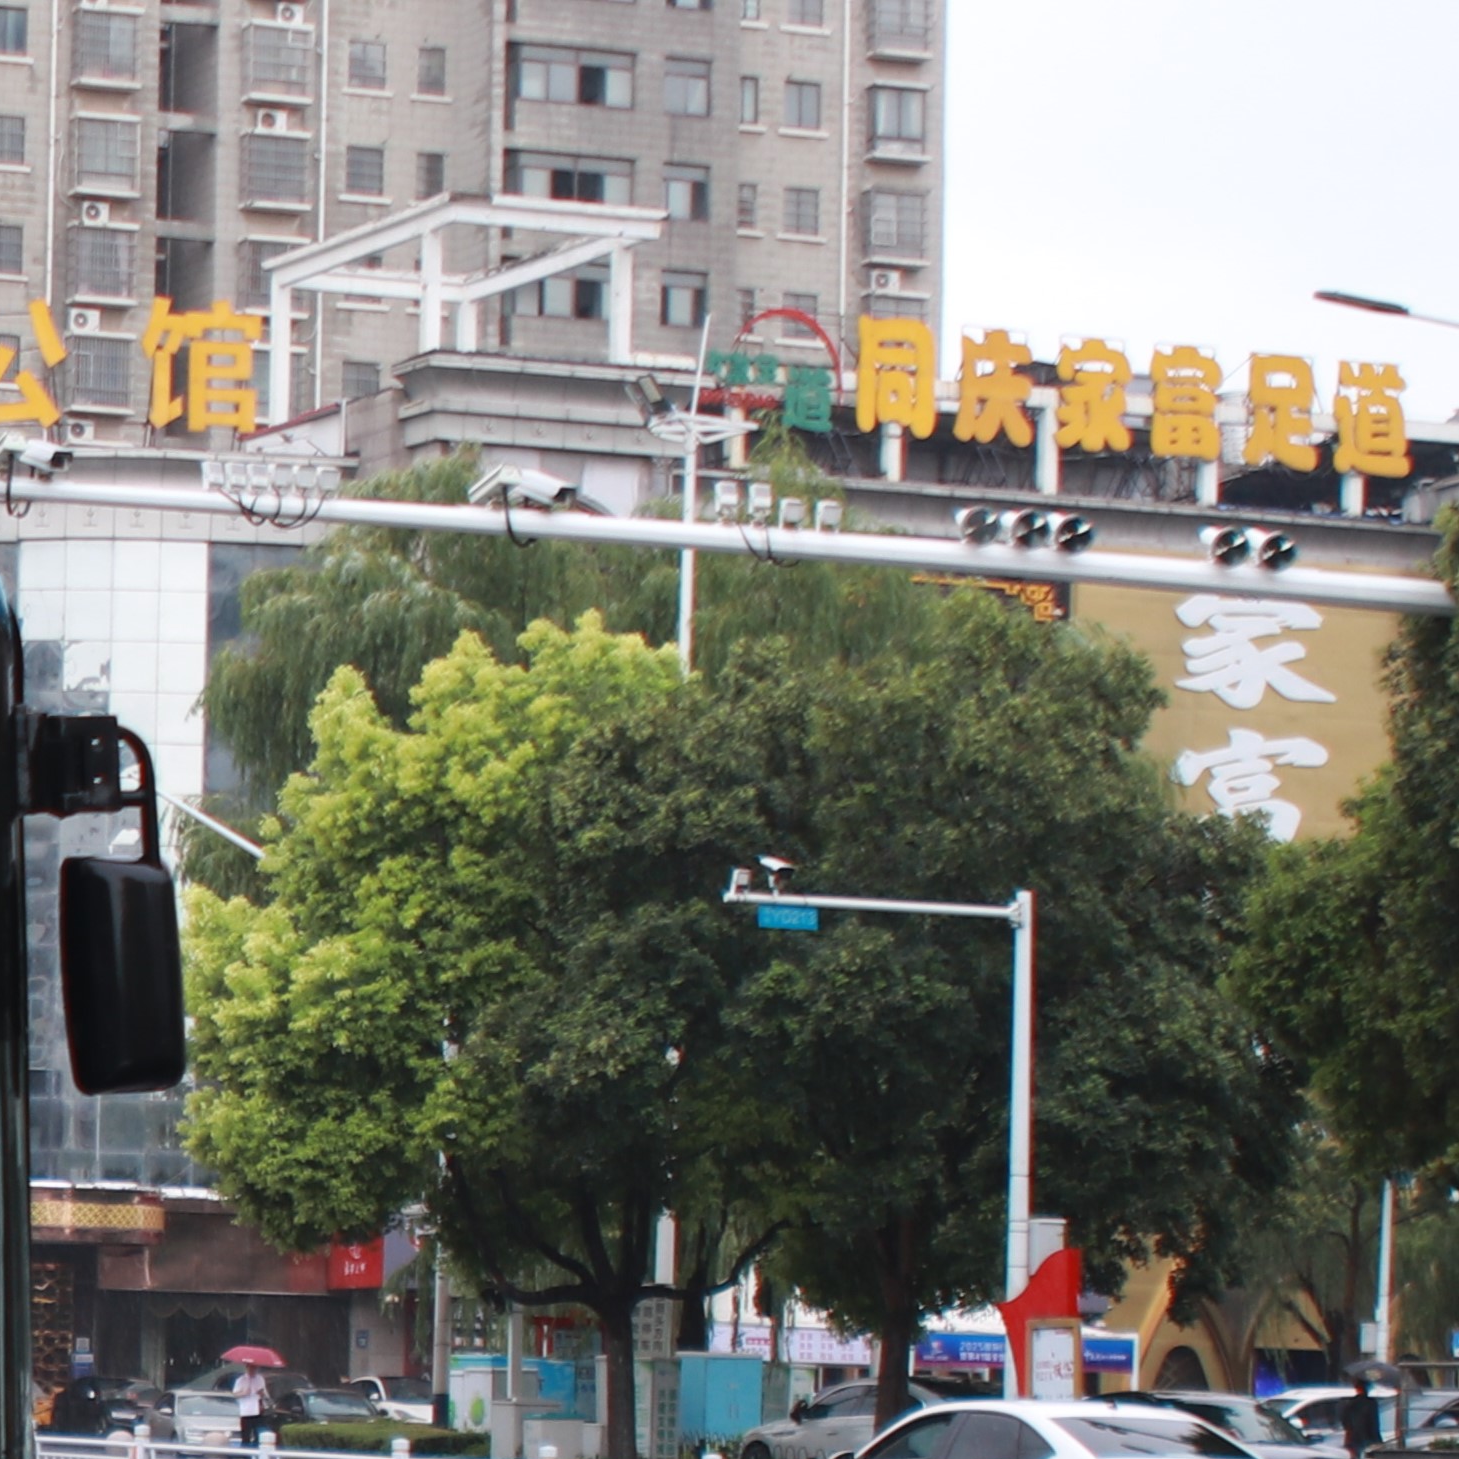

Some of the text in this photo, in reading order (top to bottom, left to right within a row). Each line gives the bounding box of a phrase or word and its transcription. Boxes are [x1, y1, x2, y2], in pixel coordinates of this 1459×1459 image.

[856, 315, 1412, 478] 同庆家富足道
